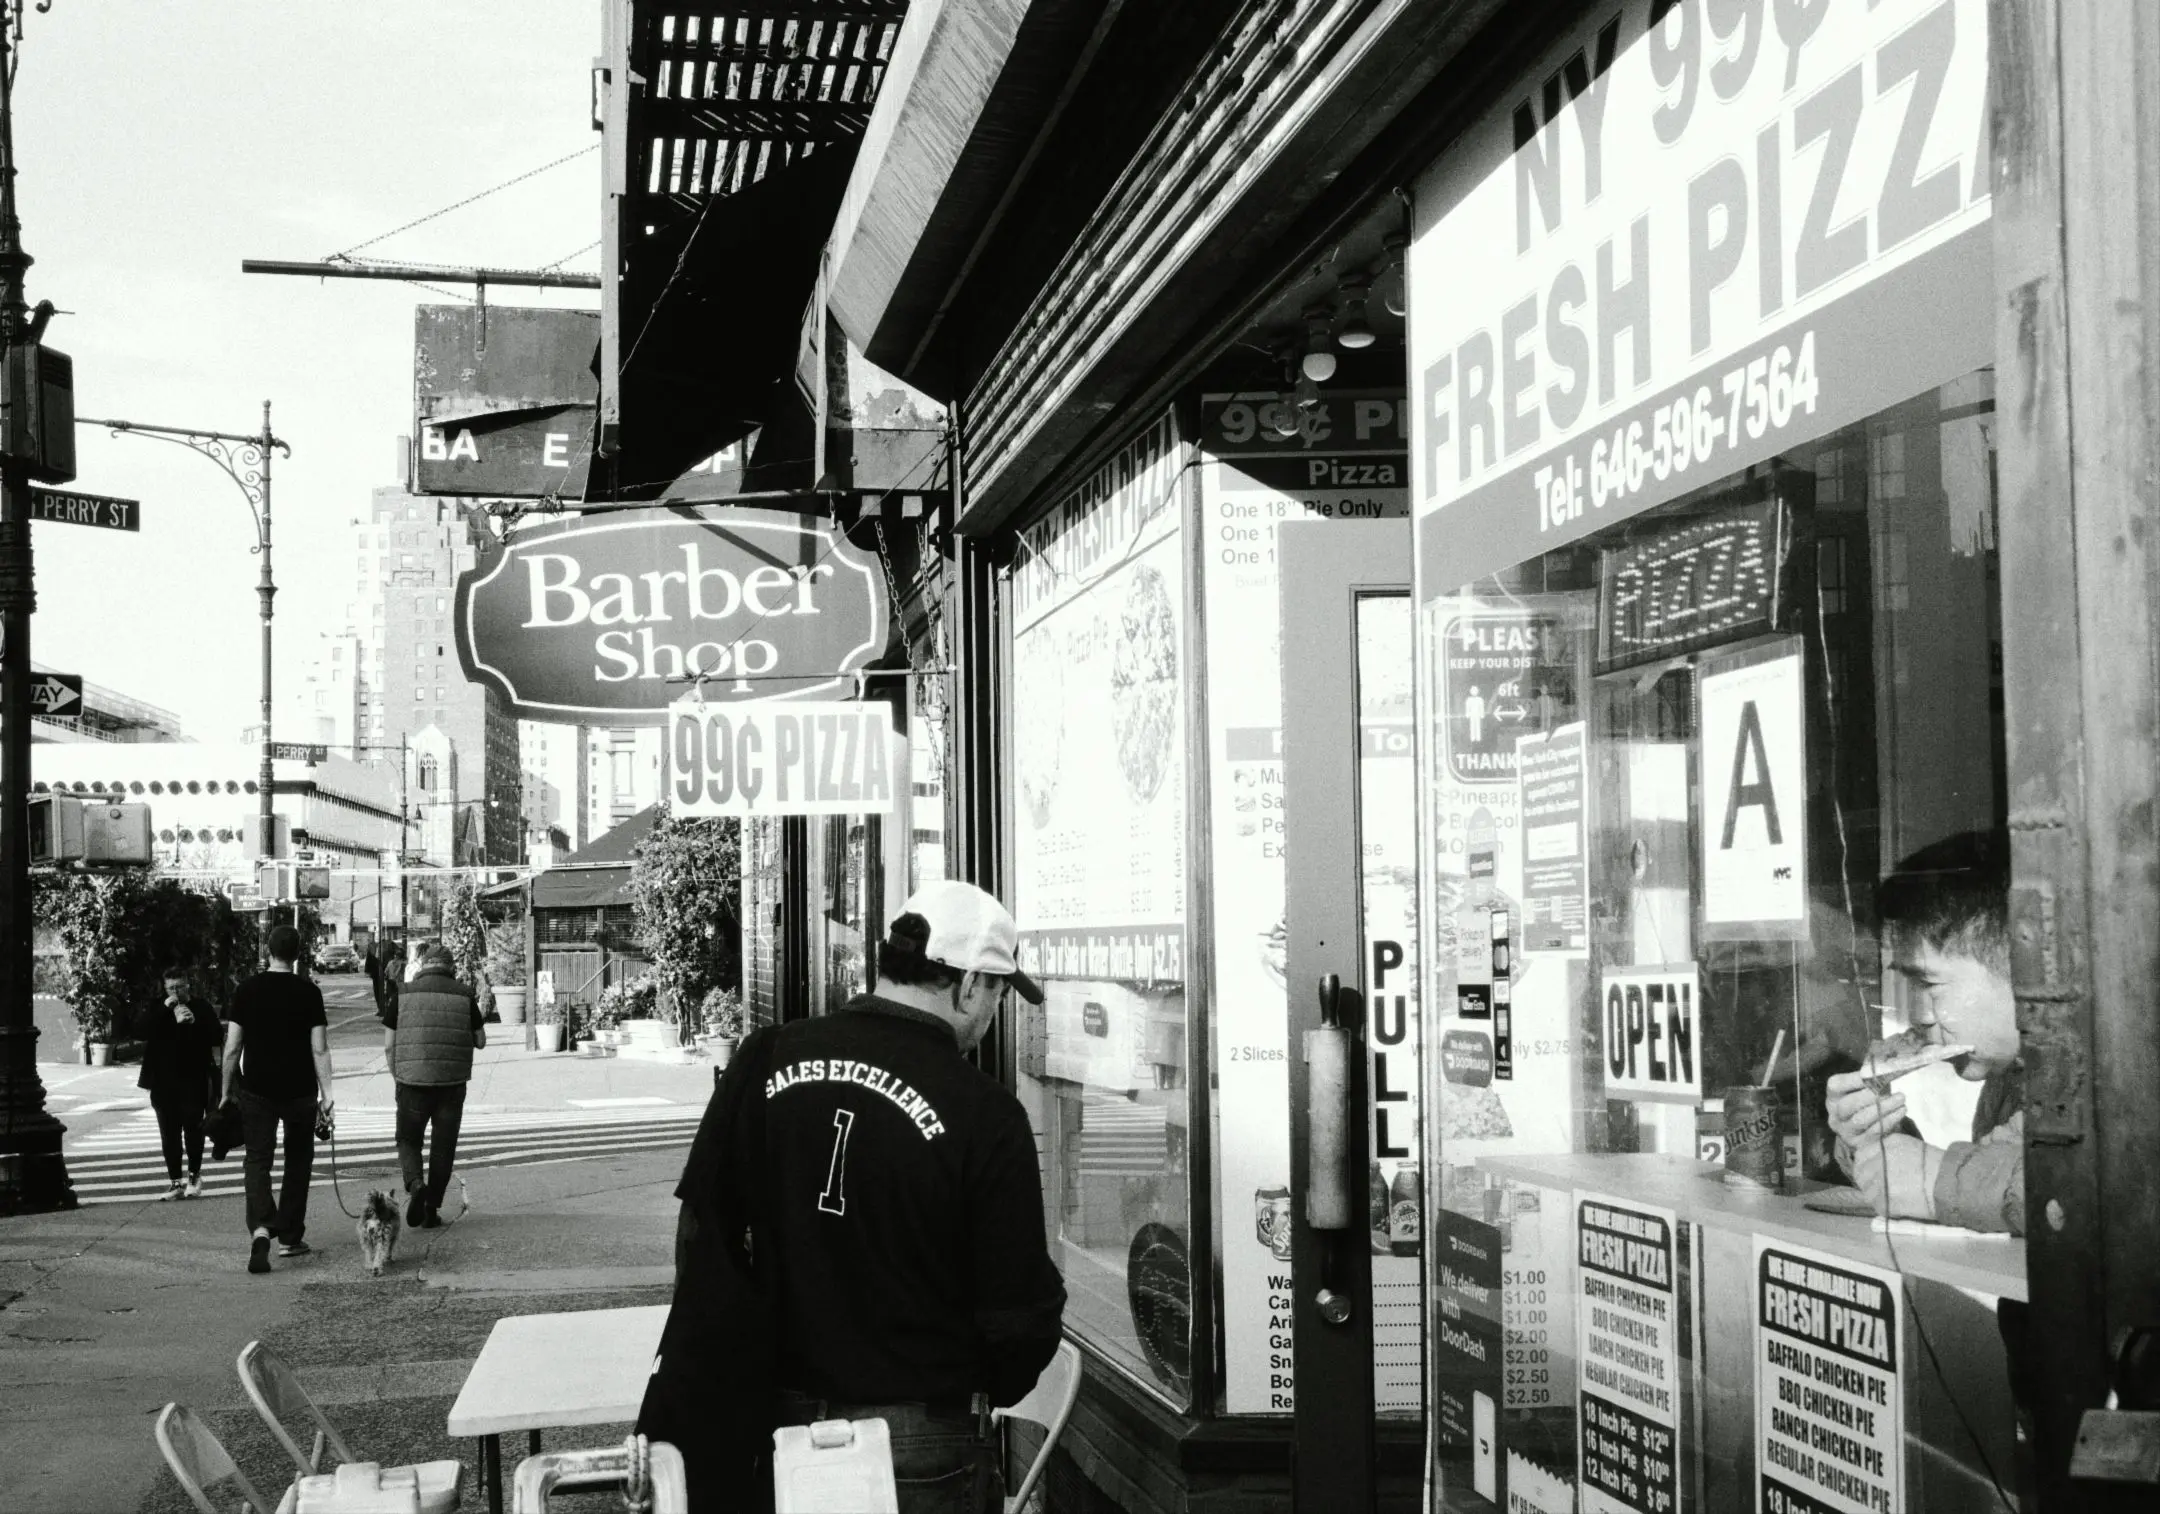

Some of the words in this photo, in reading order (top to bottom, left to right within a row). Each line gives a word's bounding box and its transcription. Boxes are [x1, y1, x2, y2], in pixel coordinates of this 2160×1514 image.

[1512, 13, 1621, 255] NY
[1423, 218, 1653, 500] FRESH
[1220, 402, 1331, 449] 99¢
[1534, 455, 1584, 532] Tel:
[1590, 330, 1818, 508] 646-596-7564
[1308, 459, 1396, 485] Pizza
[44, 495, 100, 523] PERRY
[109, 502, 128, 527] ST
[1220, 502, 1258, 518] One
[1304, 501, 1333, 517] Pie
[1339, 499, 1383, 518] Only
[1221, 526, 1259, 541] One
[1221, 549, 1259, 564] One
[517, 542, 834, 629] Barber
[1614, 524, 1768, 636] PIZZA
[595, 627, 779, 693] Shop
[1450, 658, 1476, 669] KEEP
[1479, 657, 1510, 669] YOUR
[1498, 683, 1520, 697] 6ft
[276, 745, 311, 760] PERRY
[676, 712, 762, 810] 99¢
[775, 713, 890, 803] PIZZA
[1719, 699, 1784, 851] A
[1373, 939, 1409, 1158] PULL
[1607, 982, 1694, 1084] OPEN
[765, 1059, 825, 1098] SALES
[828, 1059, 946, 1141] EXCELLENCE
[818, 1108, 855, 1216] 1
[1503, 1270, 1546, 1285] $1.00
[1582, 1228, 1625, 1272] FRESH
[1627, 1239, 1668, 1286] PIZZA
[1268, 1294, 1293, 1310] Ca
[1440, 1264, 1456, 1290] We
[1457, 1272, 1489, 1304] deliver
[1504, 1290, 1547, 1305] $1.00
[1616, 1286, 1651, 1316] CHICKEN
[1653, 1297, 1666, 1322] PIE
[1440, 1295, 1461, 1320] with
[1504, 1310, 1547, 1324] $1.00
[1765, 1281, 1826, 1341] FRESH
[1829, 1302, 1890, 1364] PIZZA
[1441, 1320, 1486, 1362] DoorDash
[1505, 1330, 1548, 1345] $2.00
[1609, 1312, 1644, 1343] CHICKEN
[1645, 1324, 1659, 1349] PIE
[1506, 1349, 1549, 1365] $2.00
[1506, 1368, 1549, 1384] $2.50
[1615, 1342, 1650, 1375] CHICKEN
[1651, 1355, 1664, 1381] PIE
[1767, 1338, 1812, 1379] BAFFALO
[1814, 1355, 1865, 1398] CHICKEN
[1867, 1374, 1887, 1406] PIE
[1506, 1388, 1549, 1405] $2.50
[1619, 1373, 1655, 1406] CHICKEN
[1656, 1387, 1670, 1413] PIE
[1778, 1376, 1802, 1410] BBQ
[1803, 1387, 1854, 1430] CHICKEN
[1856, 1406, 1875, 1438] PIE
[1585, 1400, 1596, 1424] 18
[1598, 1406, 1619, 1434] Inch
[1620, 1415, 1637, 1442] Pie
[1585, 1428, 1597, 1451] 16
[1599, 1433, 1619, 1463] Inch
[1621, 1444, 1637, 1471] Pie
[1772, 1406, 1809, 1445] RANCH
[1811, 1423, 1862, 1468] CHICKEN
[1864, 1445, 1884, 1478] PIE
[1586, 1455, 1599, 1479] 12
[1600, 1462, 1620, 1490] Inch
[1622, 1473, 1638, 1500] Pie
[1767, 1437, 1815, 1482] REGULAR
[1818, 1460, 1869, 1506] CHICKEN
[1871, 1483, 1891, 1514] PIE
[1767, 1487, 1784, 1514] 18
